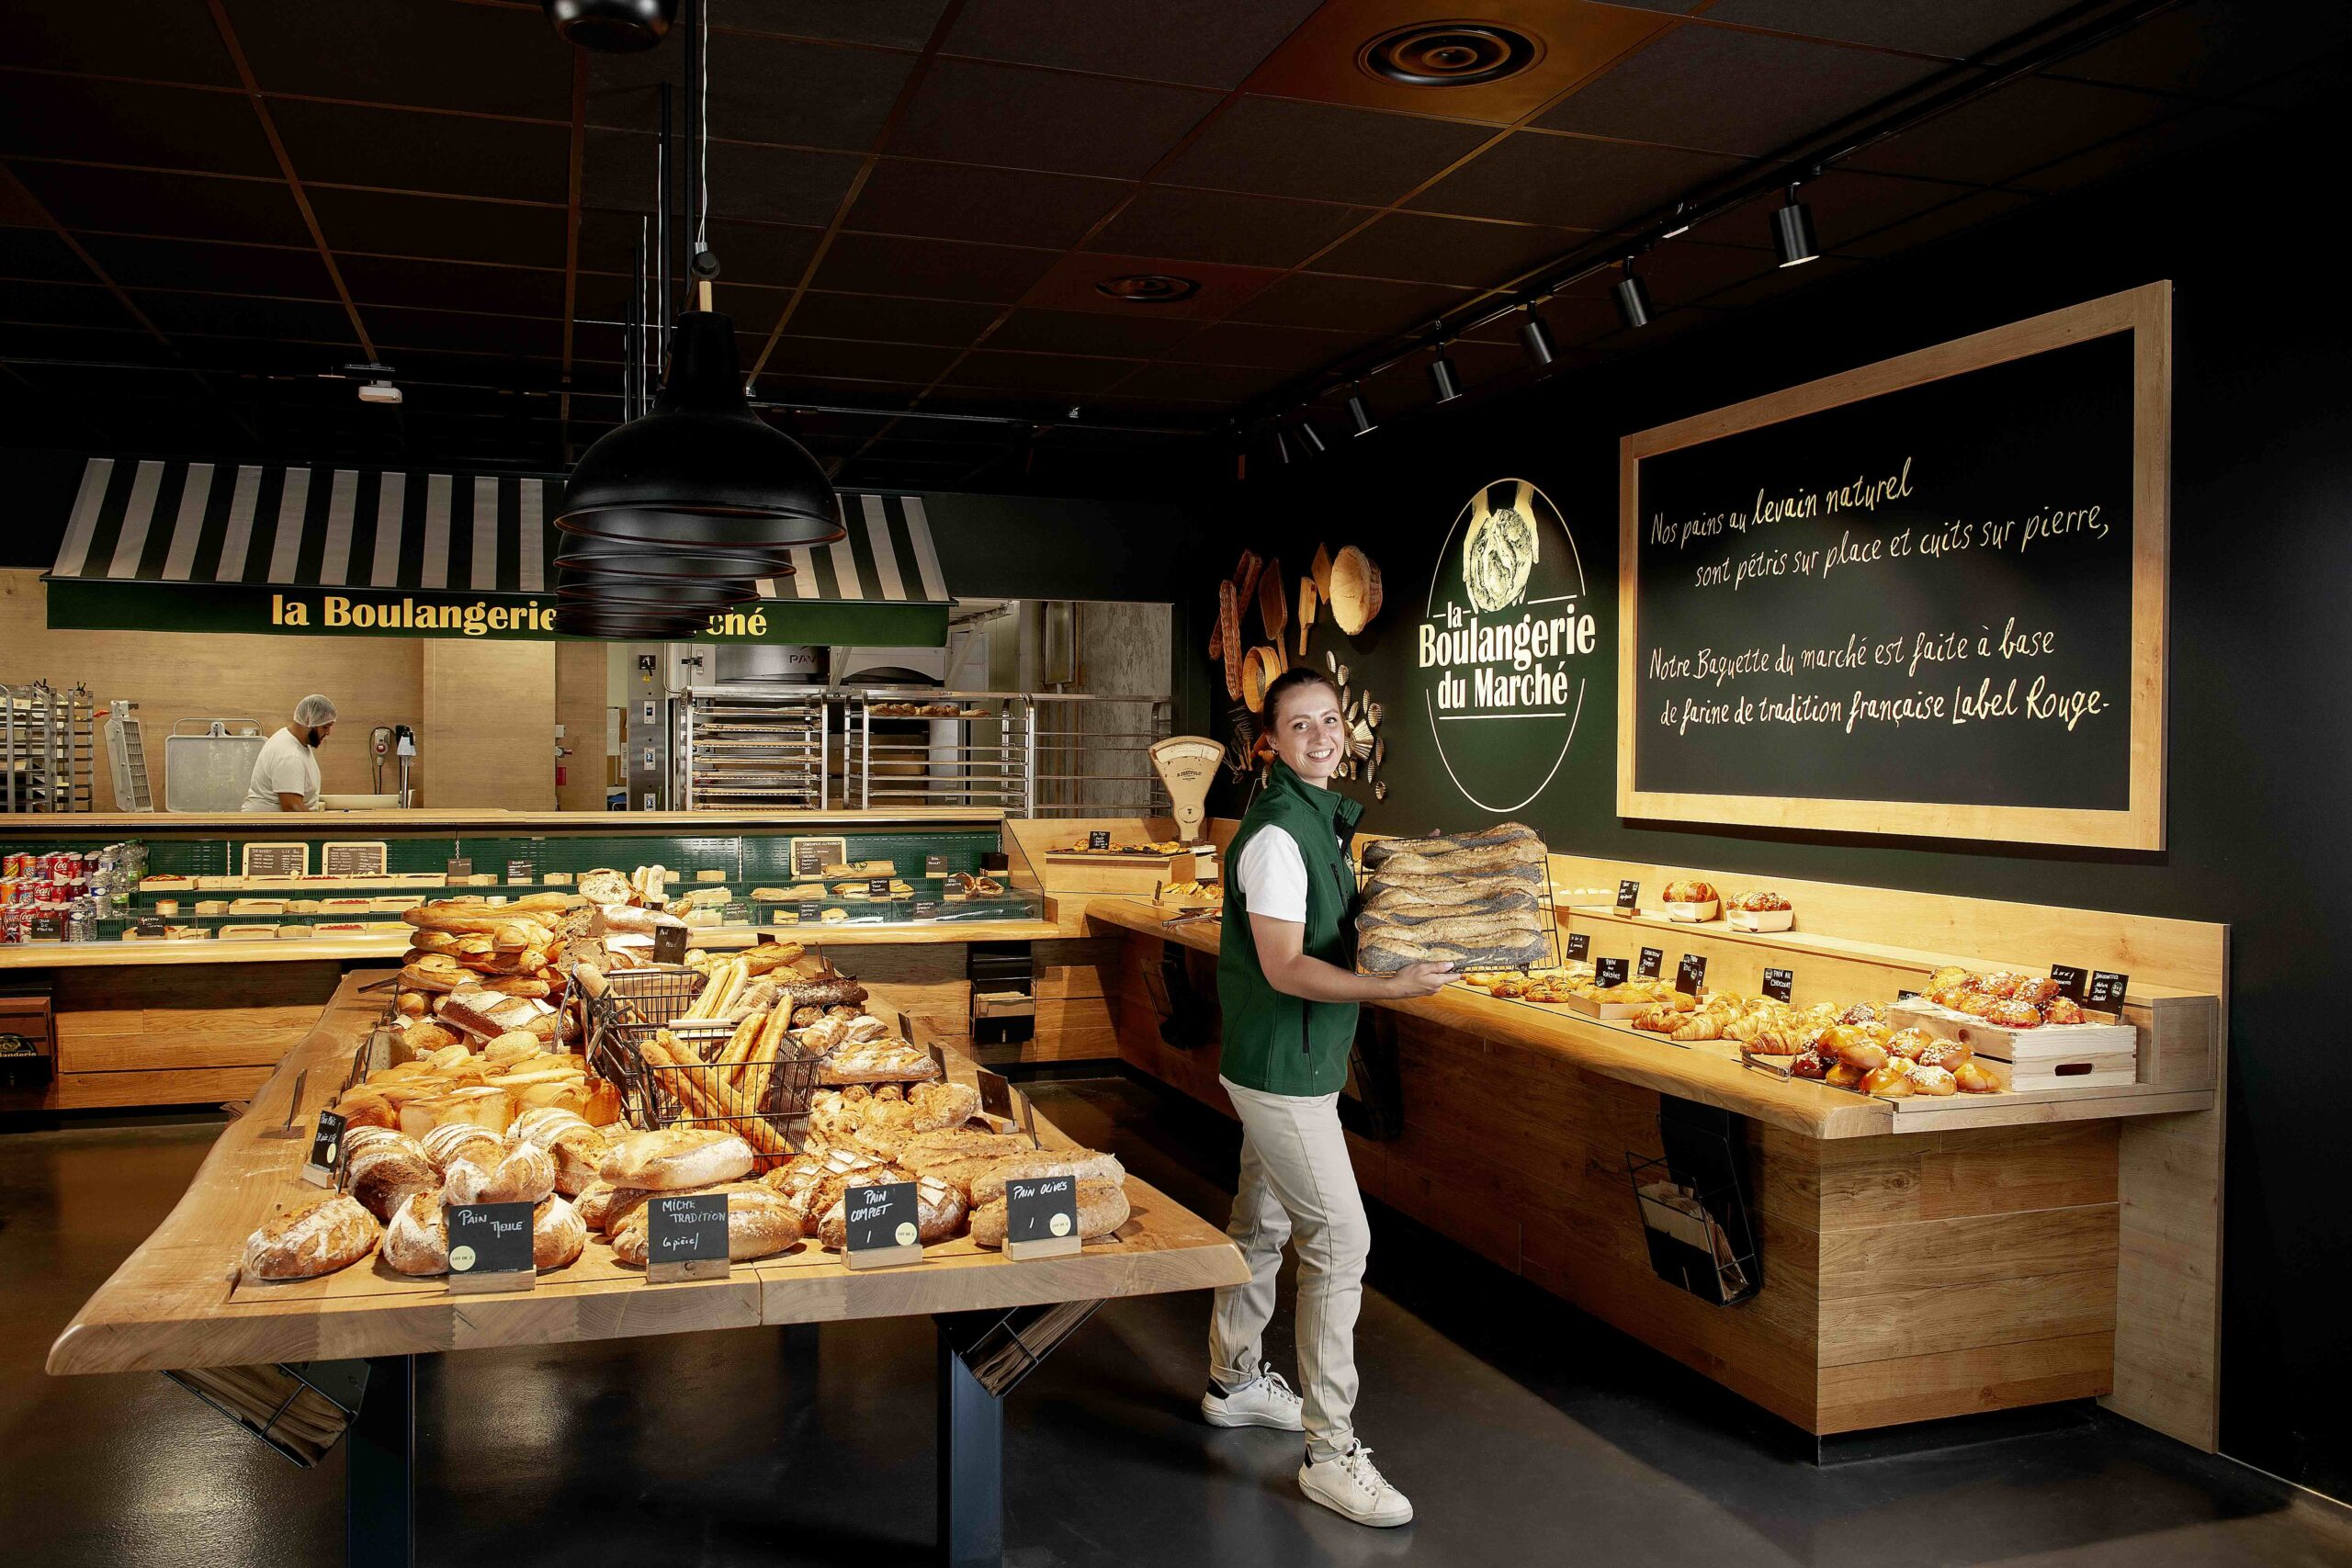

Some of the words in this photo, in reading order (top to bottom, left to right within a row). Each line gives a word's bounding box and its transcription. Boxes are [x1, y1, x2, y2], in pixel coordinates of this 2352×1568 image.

[1651, 513, 1678, 544] Nos
[1680, 513, 1724, 549] pains
[1729, 512, 1747, 534] au
[1751, 488, 1817, 525] levain
[1826, 457, 1914, 515] naturel
[1695, 557, 1731, 587] sont
[1735, 549, 1788, 591] pétris
[1792, 550, 1819, 576] sur
[1823, 530, 1882, 580] place
[1890, 527, 1912, 557] et
[1919, 519, 1973, 558] cuits
[1980, 521, 2016, 549] sur
[2021, 505, 2109, 553] pierre,
[272, 594, 311, 626] la
[324, 596, 557, 636] Boulangerie
[1419, 603, 1596, 671] Boulangerie
[1447, 601, 1463, 629] la
[1650, 647, 1690, 680] Notre
[1693, 648, 1770, 687] Baguette
[1775, 644, 1794, 676] du
[1801, 633, 1868, 669] marché
[1874, 637, 1905, 666] est
[1909, 632, 1969, 677] faite
[1978, 626, 1991, 657] à
[1998, 616, 2055, 660] base
[1438, 670, 1466, 710] du
[1475, 660, 1568, 708] Marché
[1661, 700, 1678, 726] de
[1679, 698, 1730, 736] farine
[1734, 695, 1754, 725] de
[1758, 694, 1841, 724] tradition
[1846, 691, 1945, 734] française
[1952, 677, 2018, 725] Label
